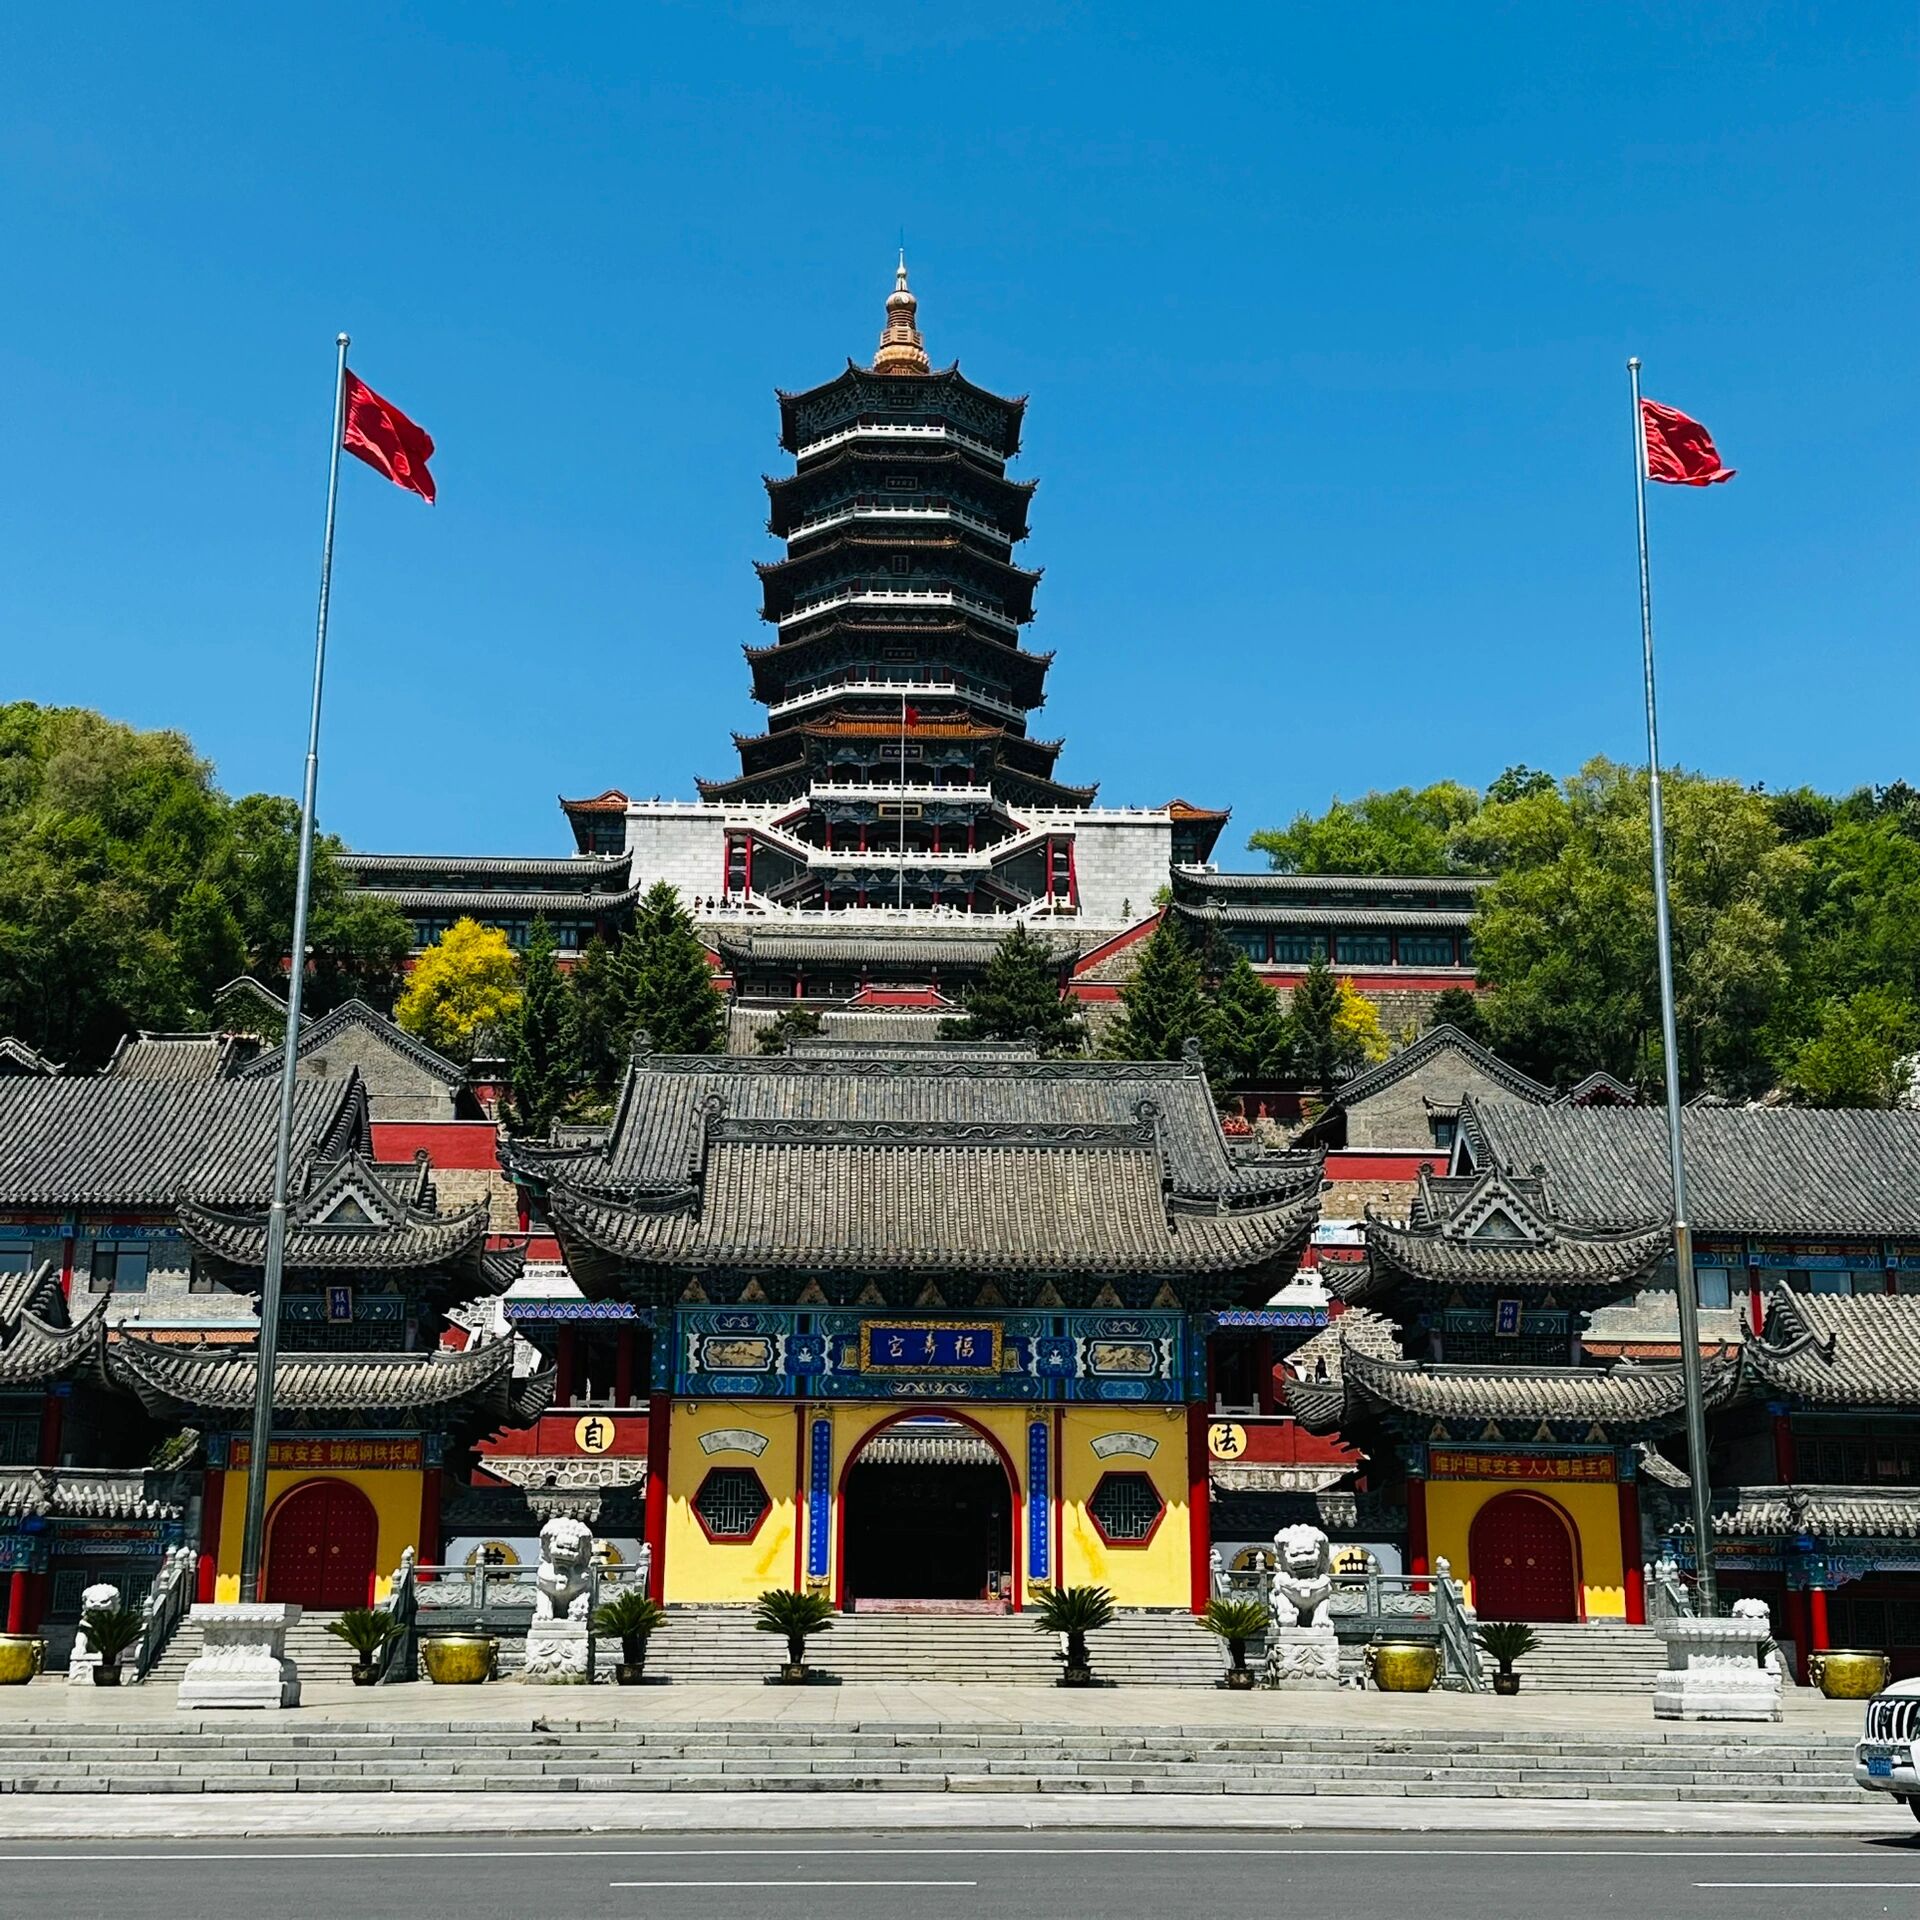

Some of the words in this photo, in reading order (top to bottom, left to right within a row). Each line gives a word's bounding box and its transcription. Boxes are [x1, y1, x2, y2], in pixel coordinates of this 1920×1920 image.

[585, 1417, 603, 1449] 自
[1214, 1423, 1238, 1453] 法
[235, 1444, 324, 1462] 捍国家安全
[1435, 1455, 1521, 1474] 维护国家安全
[1527, 1459, 1611, 1476] 人人都是主角
